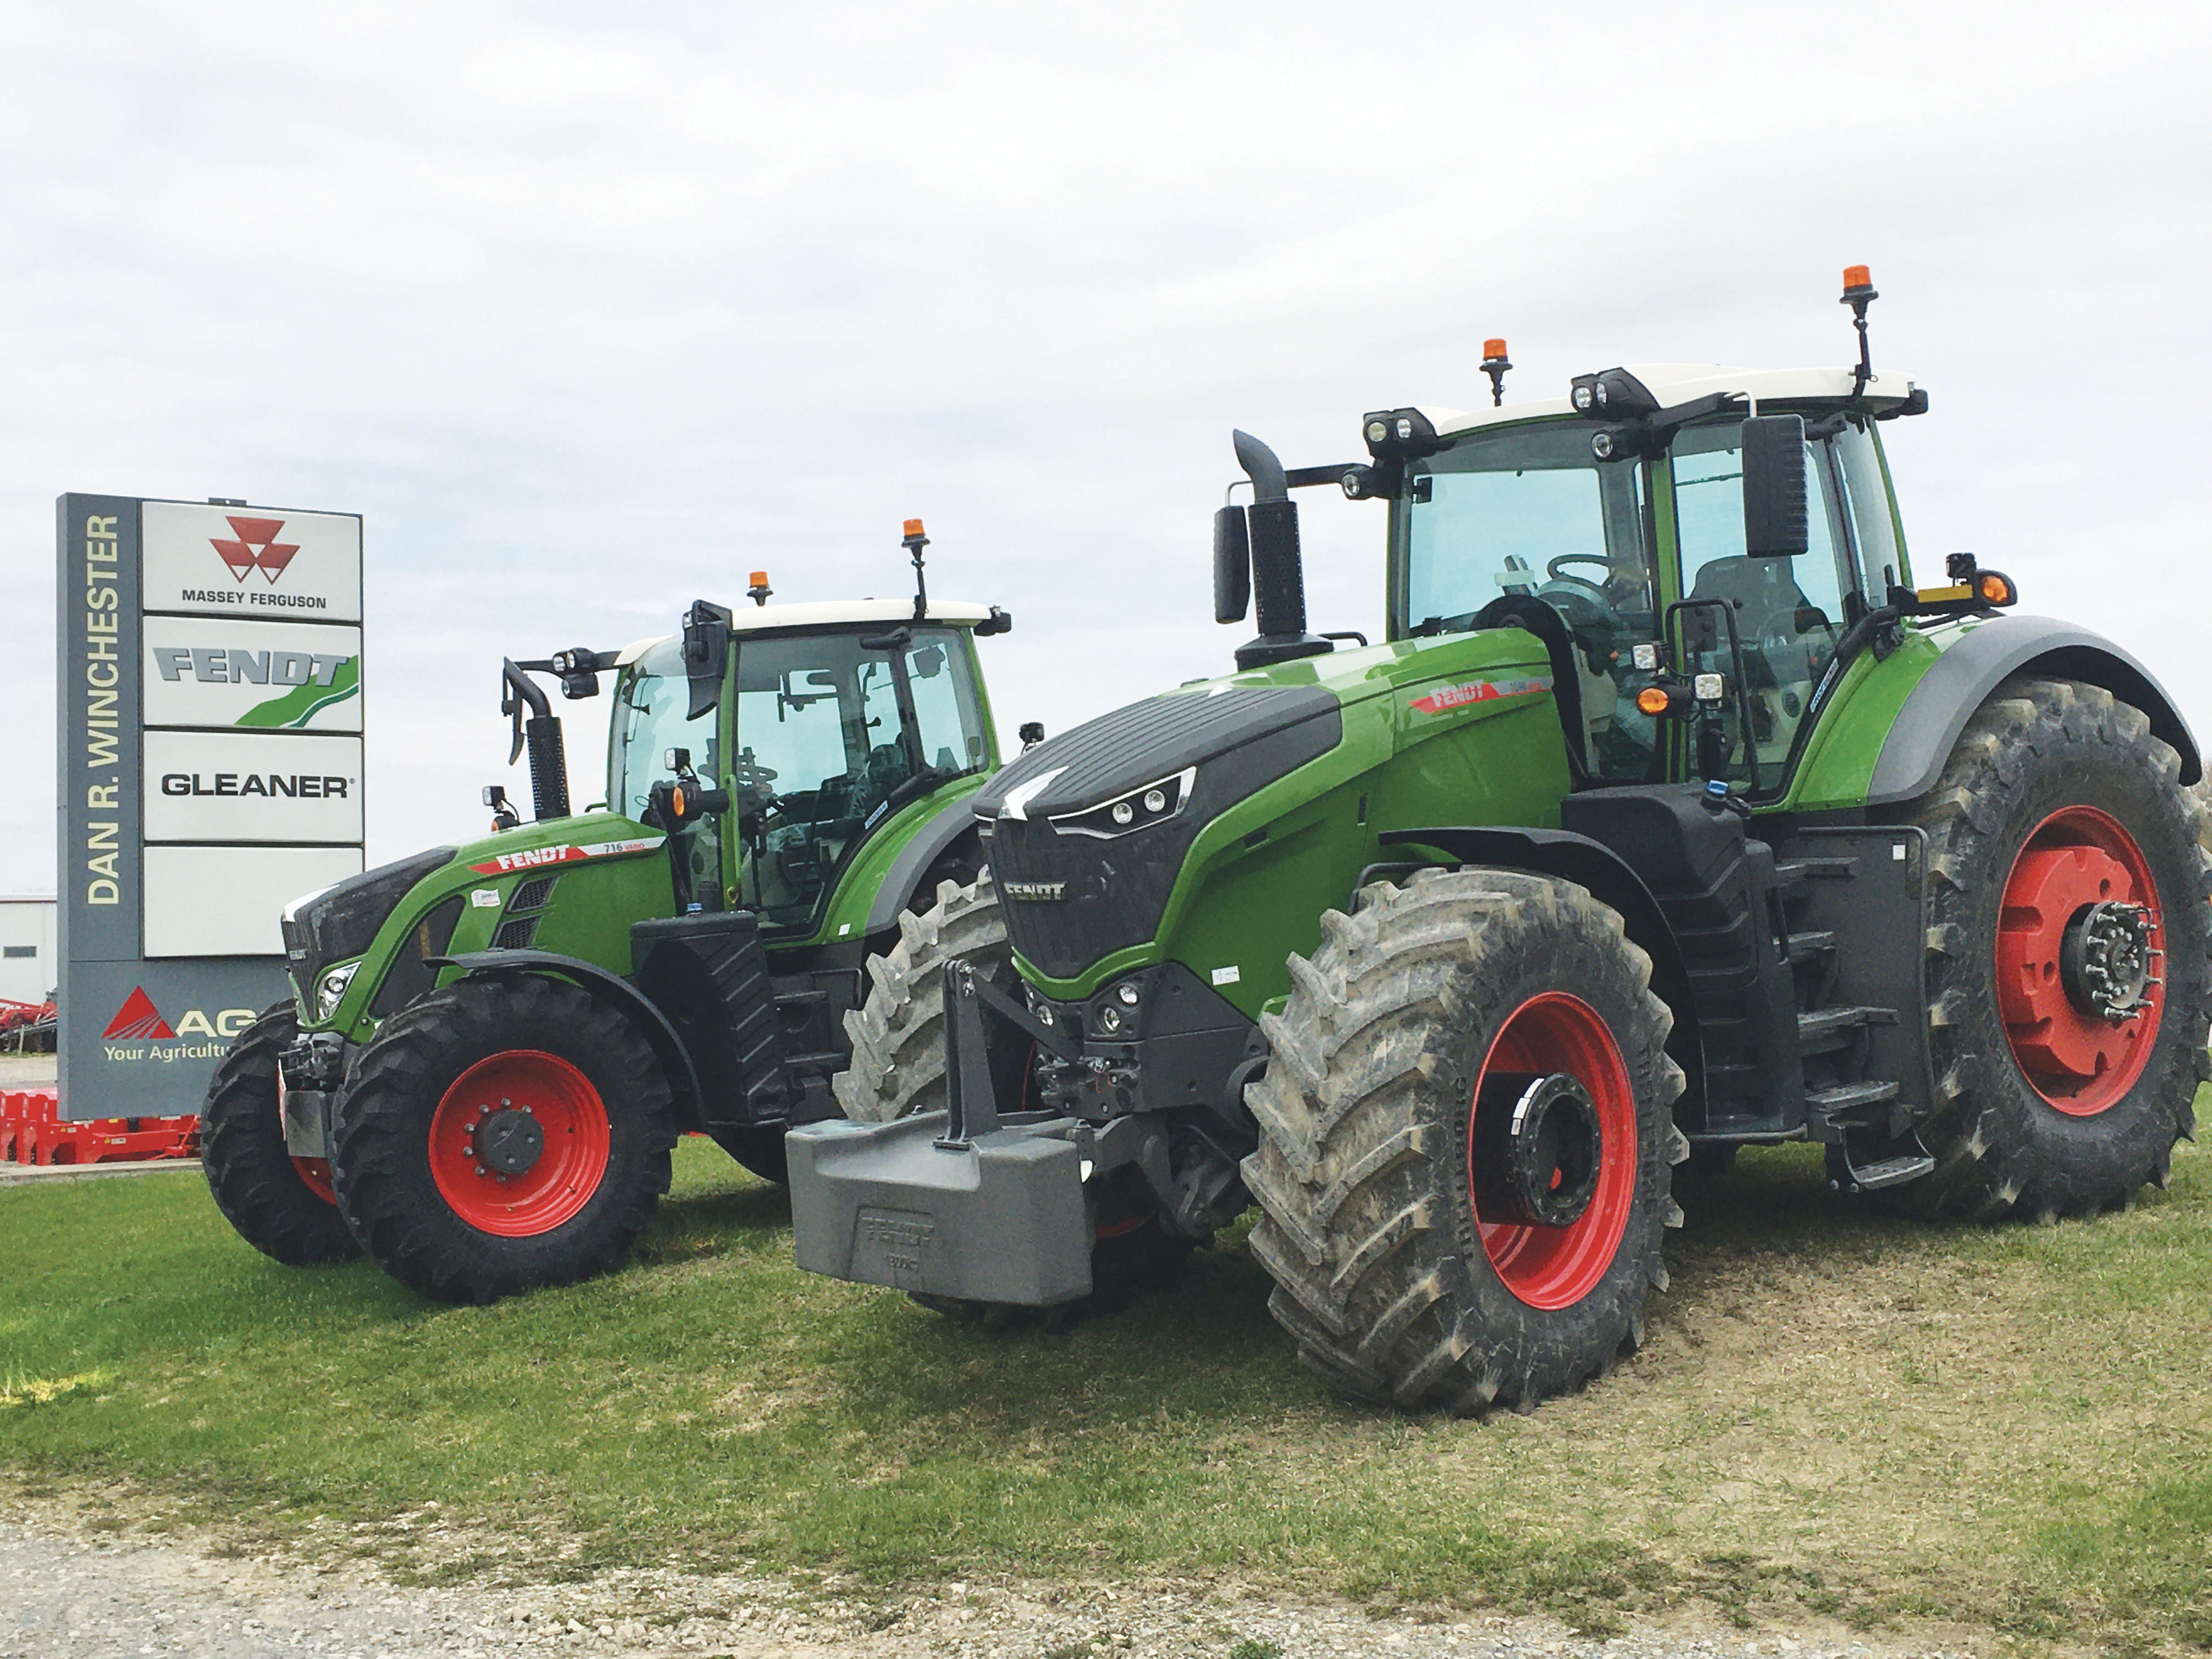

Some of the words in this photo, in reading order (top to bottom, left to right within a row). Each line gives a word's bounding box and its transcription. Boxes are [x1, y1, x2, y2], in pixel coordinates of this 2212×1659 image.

[182, 589, 245, 603] MASSEY
[250, 593, 326, 608] FERGUSON
[86, 515, 119, 768] WINCHESTER
[152, 647, 349, 687] FENDT
[1430, 679, 1483, 707] FENDT
[88, 776, 119, 808] R.
[496, 844, 570, 870] FENDT
[604, 843, 623, 853] 716
[87, 822, 119, 904] DAN
[175, 1008, 262, 1037] AG
[104, 1046, 144, 1061] Your
